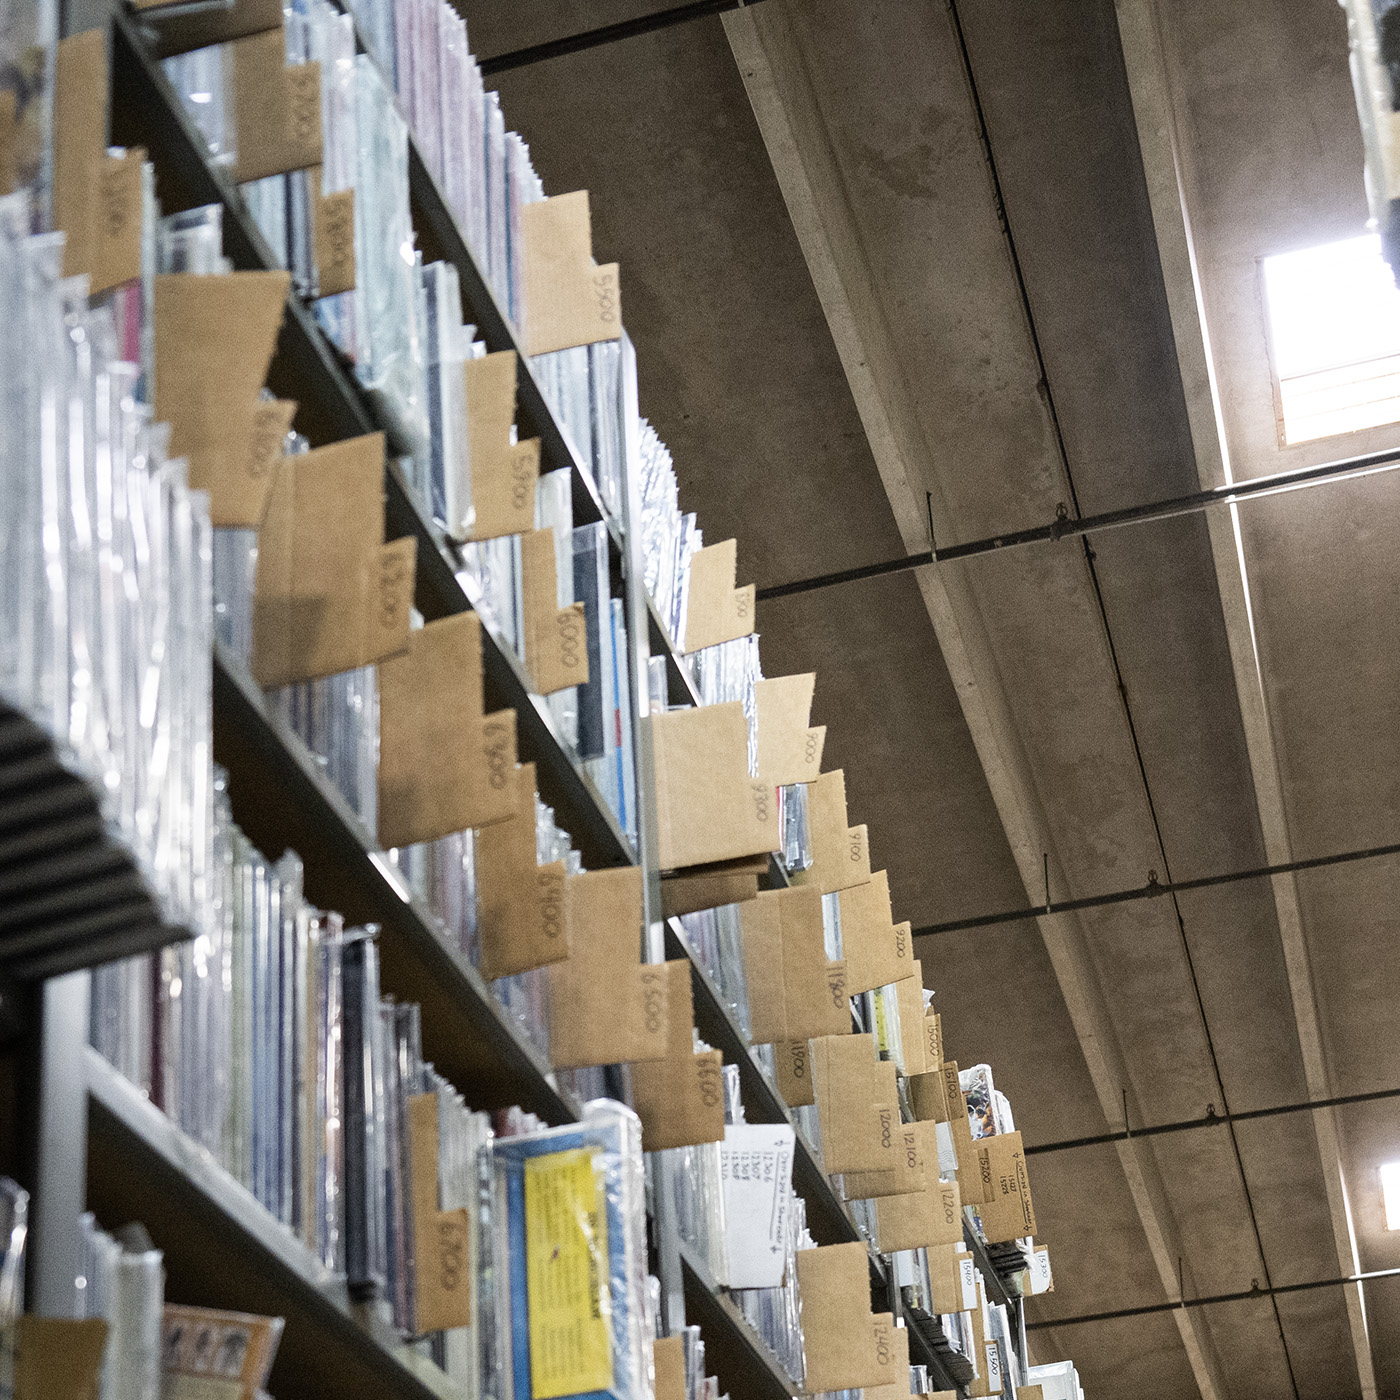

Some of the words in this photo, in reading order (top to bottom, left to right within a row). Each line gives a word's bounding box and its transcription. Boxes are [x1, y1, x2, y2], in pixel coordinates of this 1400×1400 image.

[556, 612, 580, 668] 6000
[803, 733, 819, 764] 9000
[750, 783, 769, 822] 9300
[848, 832, 862, 862] 9100
[894, 929, 906, 959] 9200
[825, 966, 847, 1010] 11800
[926, 1023, 940, 1057] 15000
[789, 1038, 806, 1079] 11900
[695, 1058, 718, 1108] 6600
[944, 1067, 958, 1100] 15100
[877, 1108, 892, 1149] 12000
[750, 1151, 761, 1180] 12307
[762, 1151, 774, 1183] 12306
[902, 1132, 917, 1169] 12100
[978, 1156, 991, 1184] 15200
[939, 1188, 955, 1225] 12200
[439, 1222, 464, 1292] 6700
[961, 1261, 973, 1286] 15400
[1035, 1254, 1050, 1280] 15300
[872, 1321, 890, 1366] 12400
[987, 1346, 999, 1376] 15500
